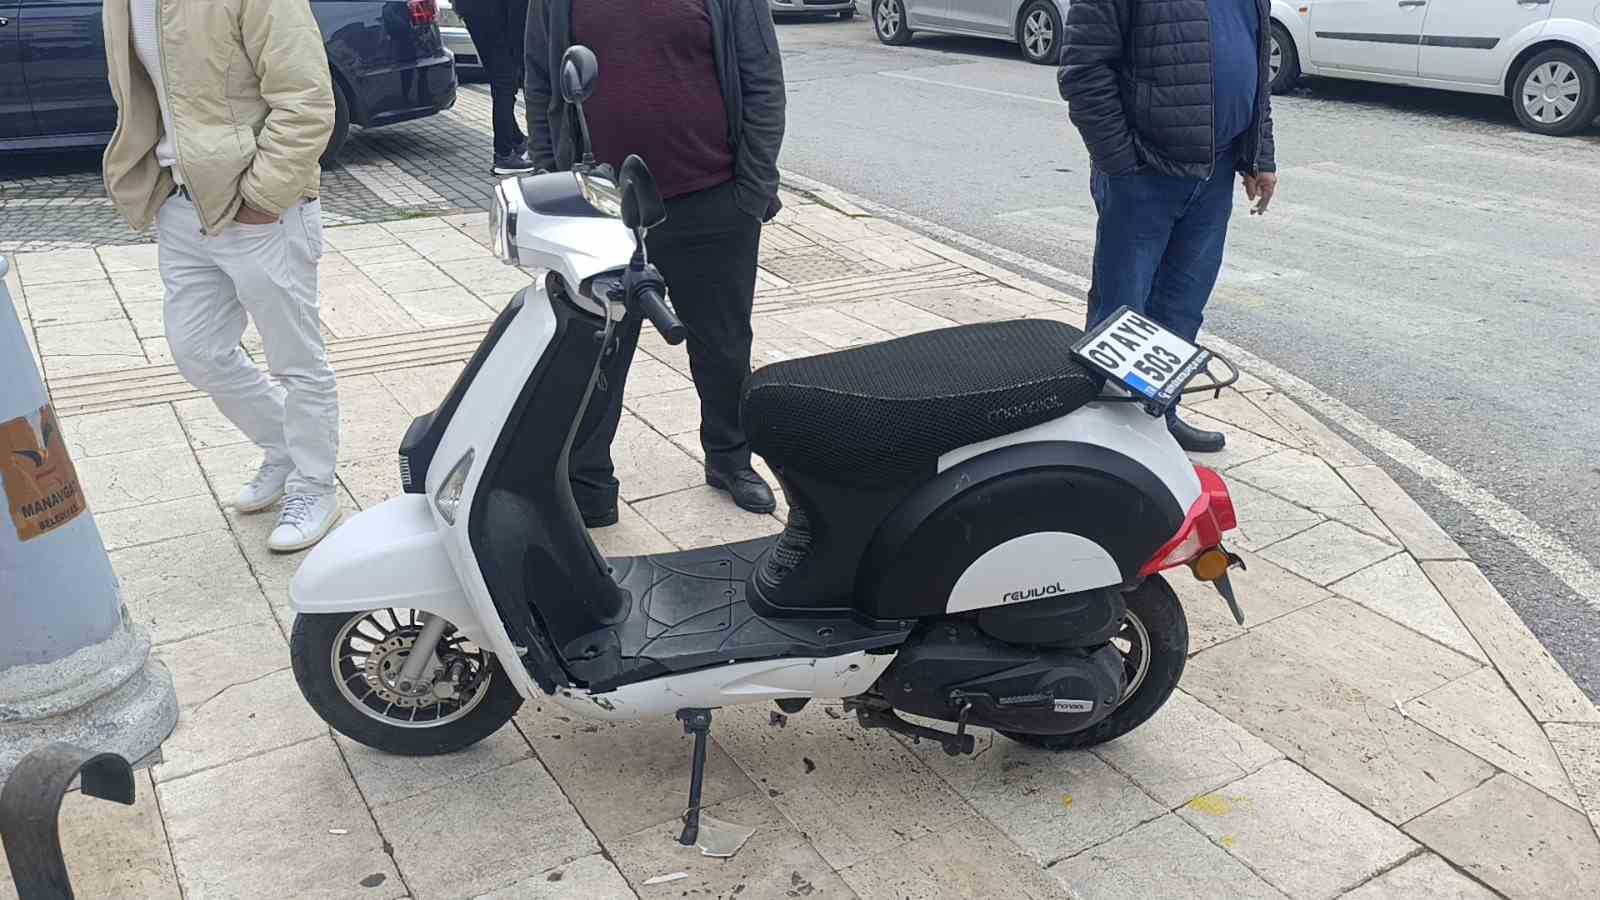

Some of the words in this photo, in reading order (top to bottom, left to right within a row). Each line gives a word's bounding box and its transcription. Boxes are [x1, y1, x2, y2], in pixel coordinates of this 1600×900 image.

[1089, 341, 1126, 369] 07
[1110, 315, 1159, 351] AYH
[1133, 345, 1181, 381] 503
[1003, 582, 1065, 602] revival
